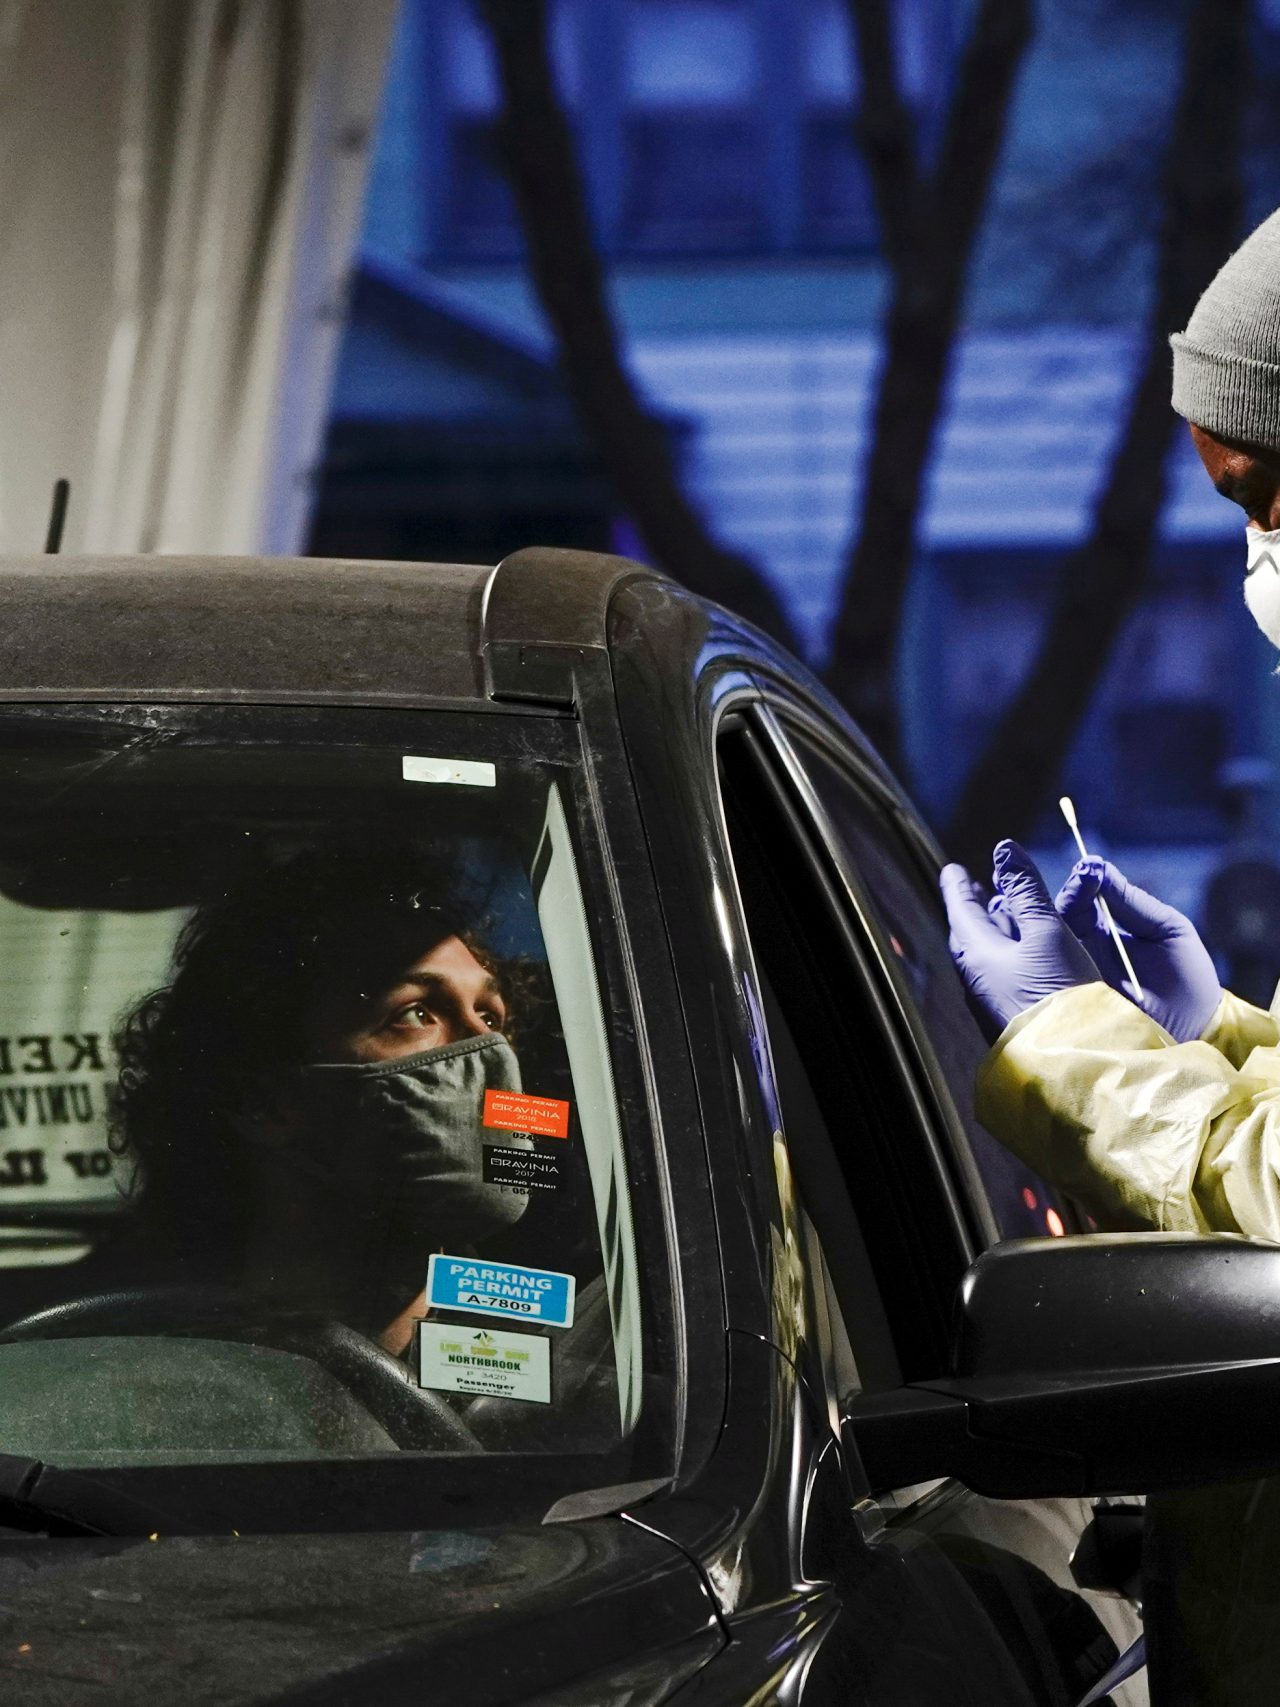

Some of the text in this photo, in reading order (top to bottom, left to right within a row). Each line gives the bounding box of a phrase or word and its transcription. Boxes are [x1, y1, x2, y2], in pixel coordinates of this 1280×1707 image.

[503, 1104, 560, 1120] RAVINIA
[493, 1148, 527, 1157] PARKING
[502, 1158, 560, 1174] RAVINIA
[515, 1169, 535, 1178] 2017
[493, 1177, 557, 1190] PARKING PERMIT
[450, 1264, 553, 1291] PARKING
[458, 1278, 544, 1301] PERMIT
[466, 1295, 532, 1313] A-7809
[448, 1354, 521, 1371] NORTHBROOK
[456, 1377, 516, 1391] Passenger
